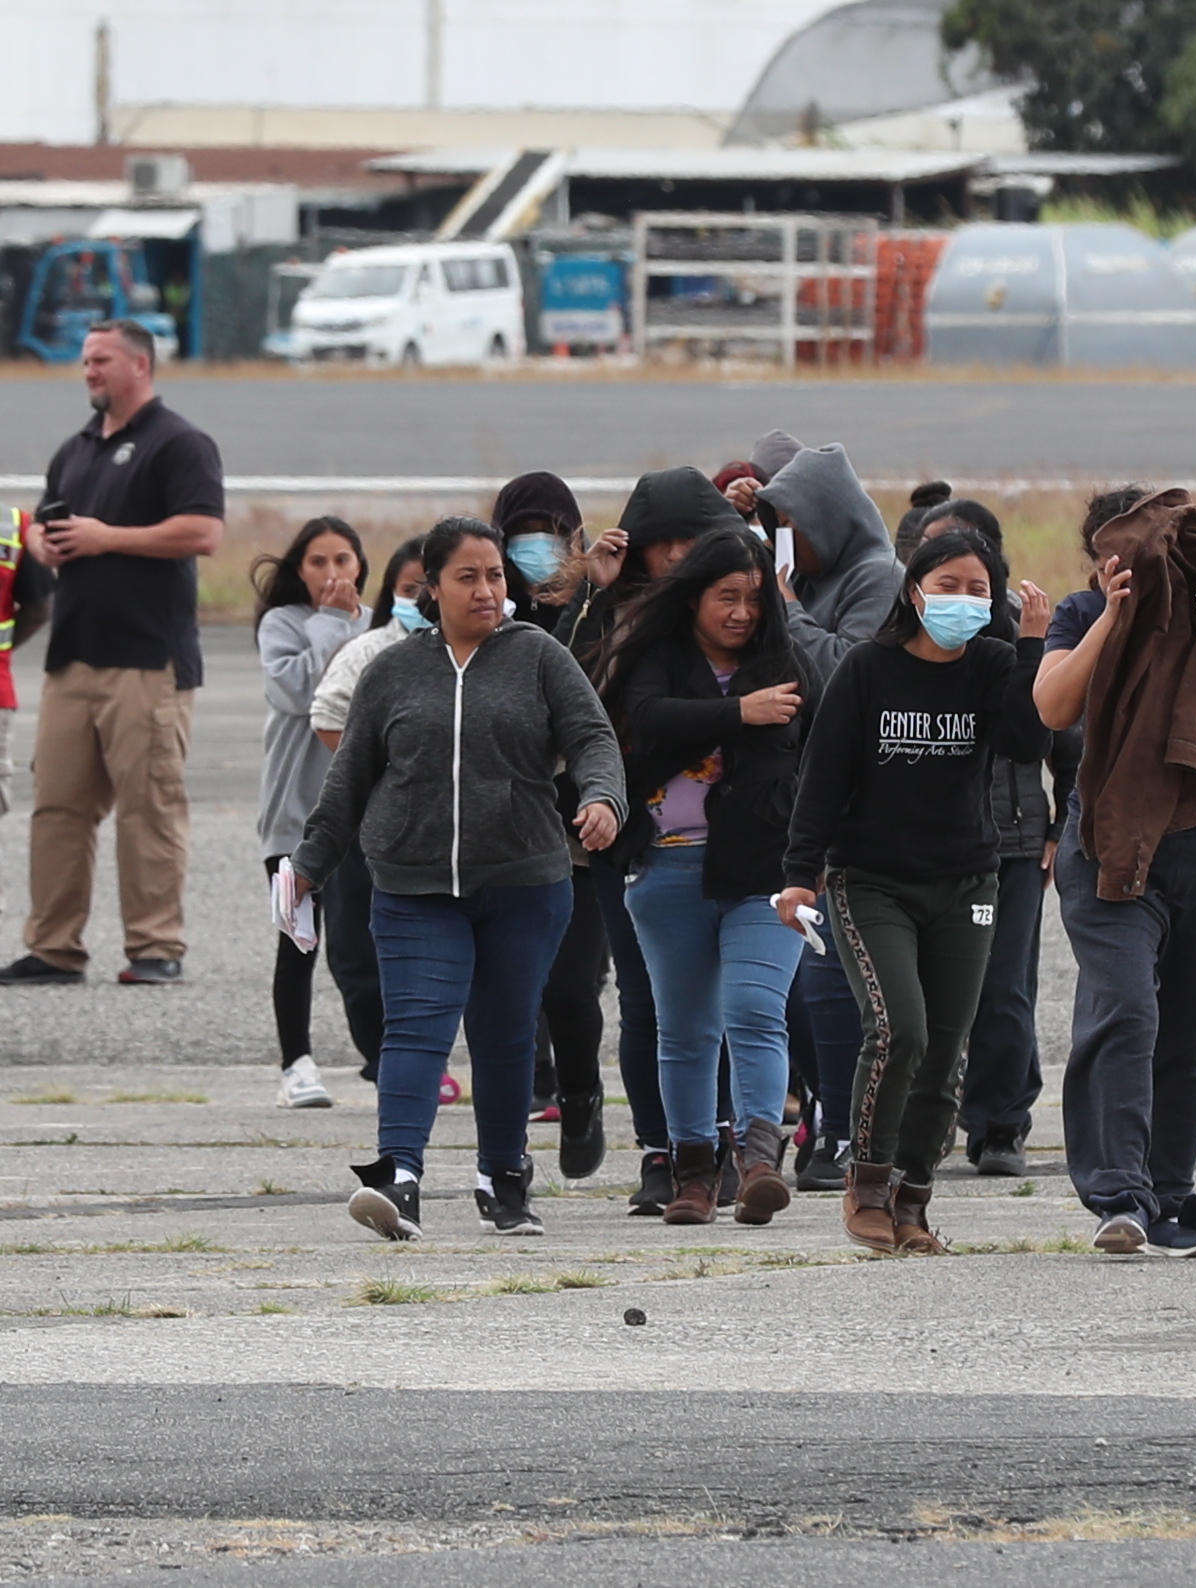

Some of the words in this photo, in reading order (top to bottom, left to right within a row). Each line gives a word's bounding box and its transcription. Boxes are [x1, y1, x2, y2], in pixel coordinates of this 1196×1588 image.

[880, 710, 931, 739] CENTER
[878, 742, 925, 765] Performing
[924, 744, 945, 756] Arts
[978, 909, 991, 922] 72
